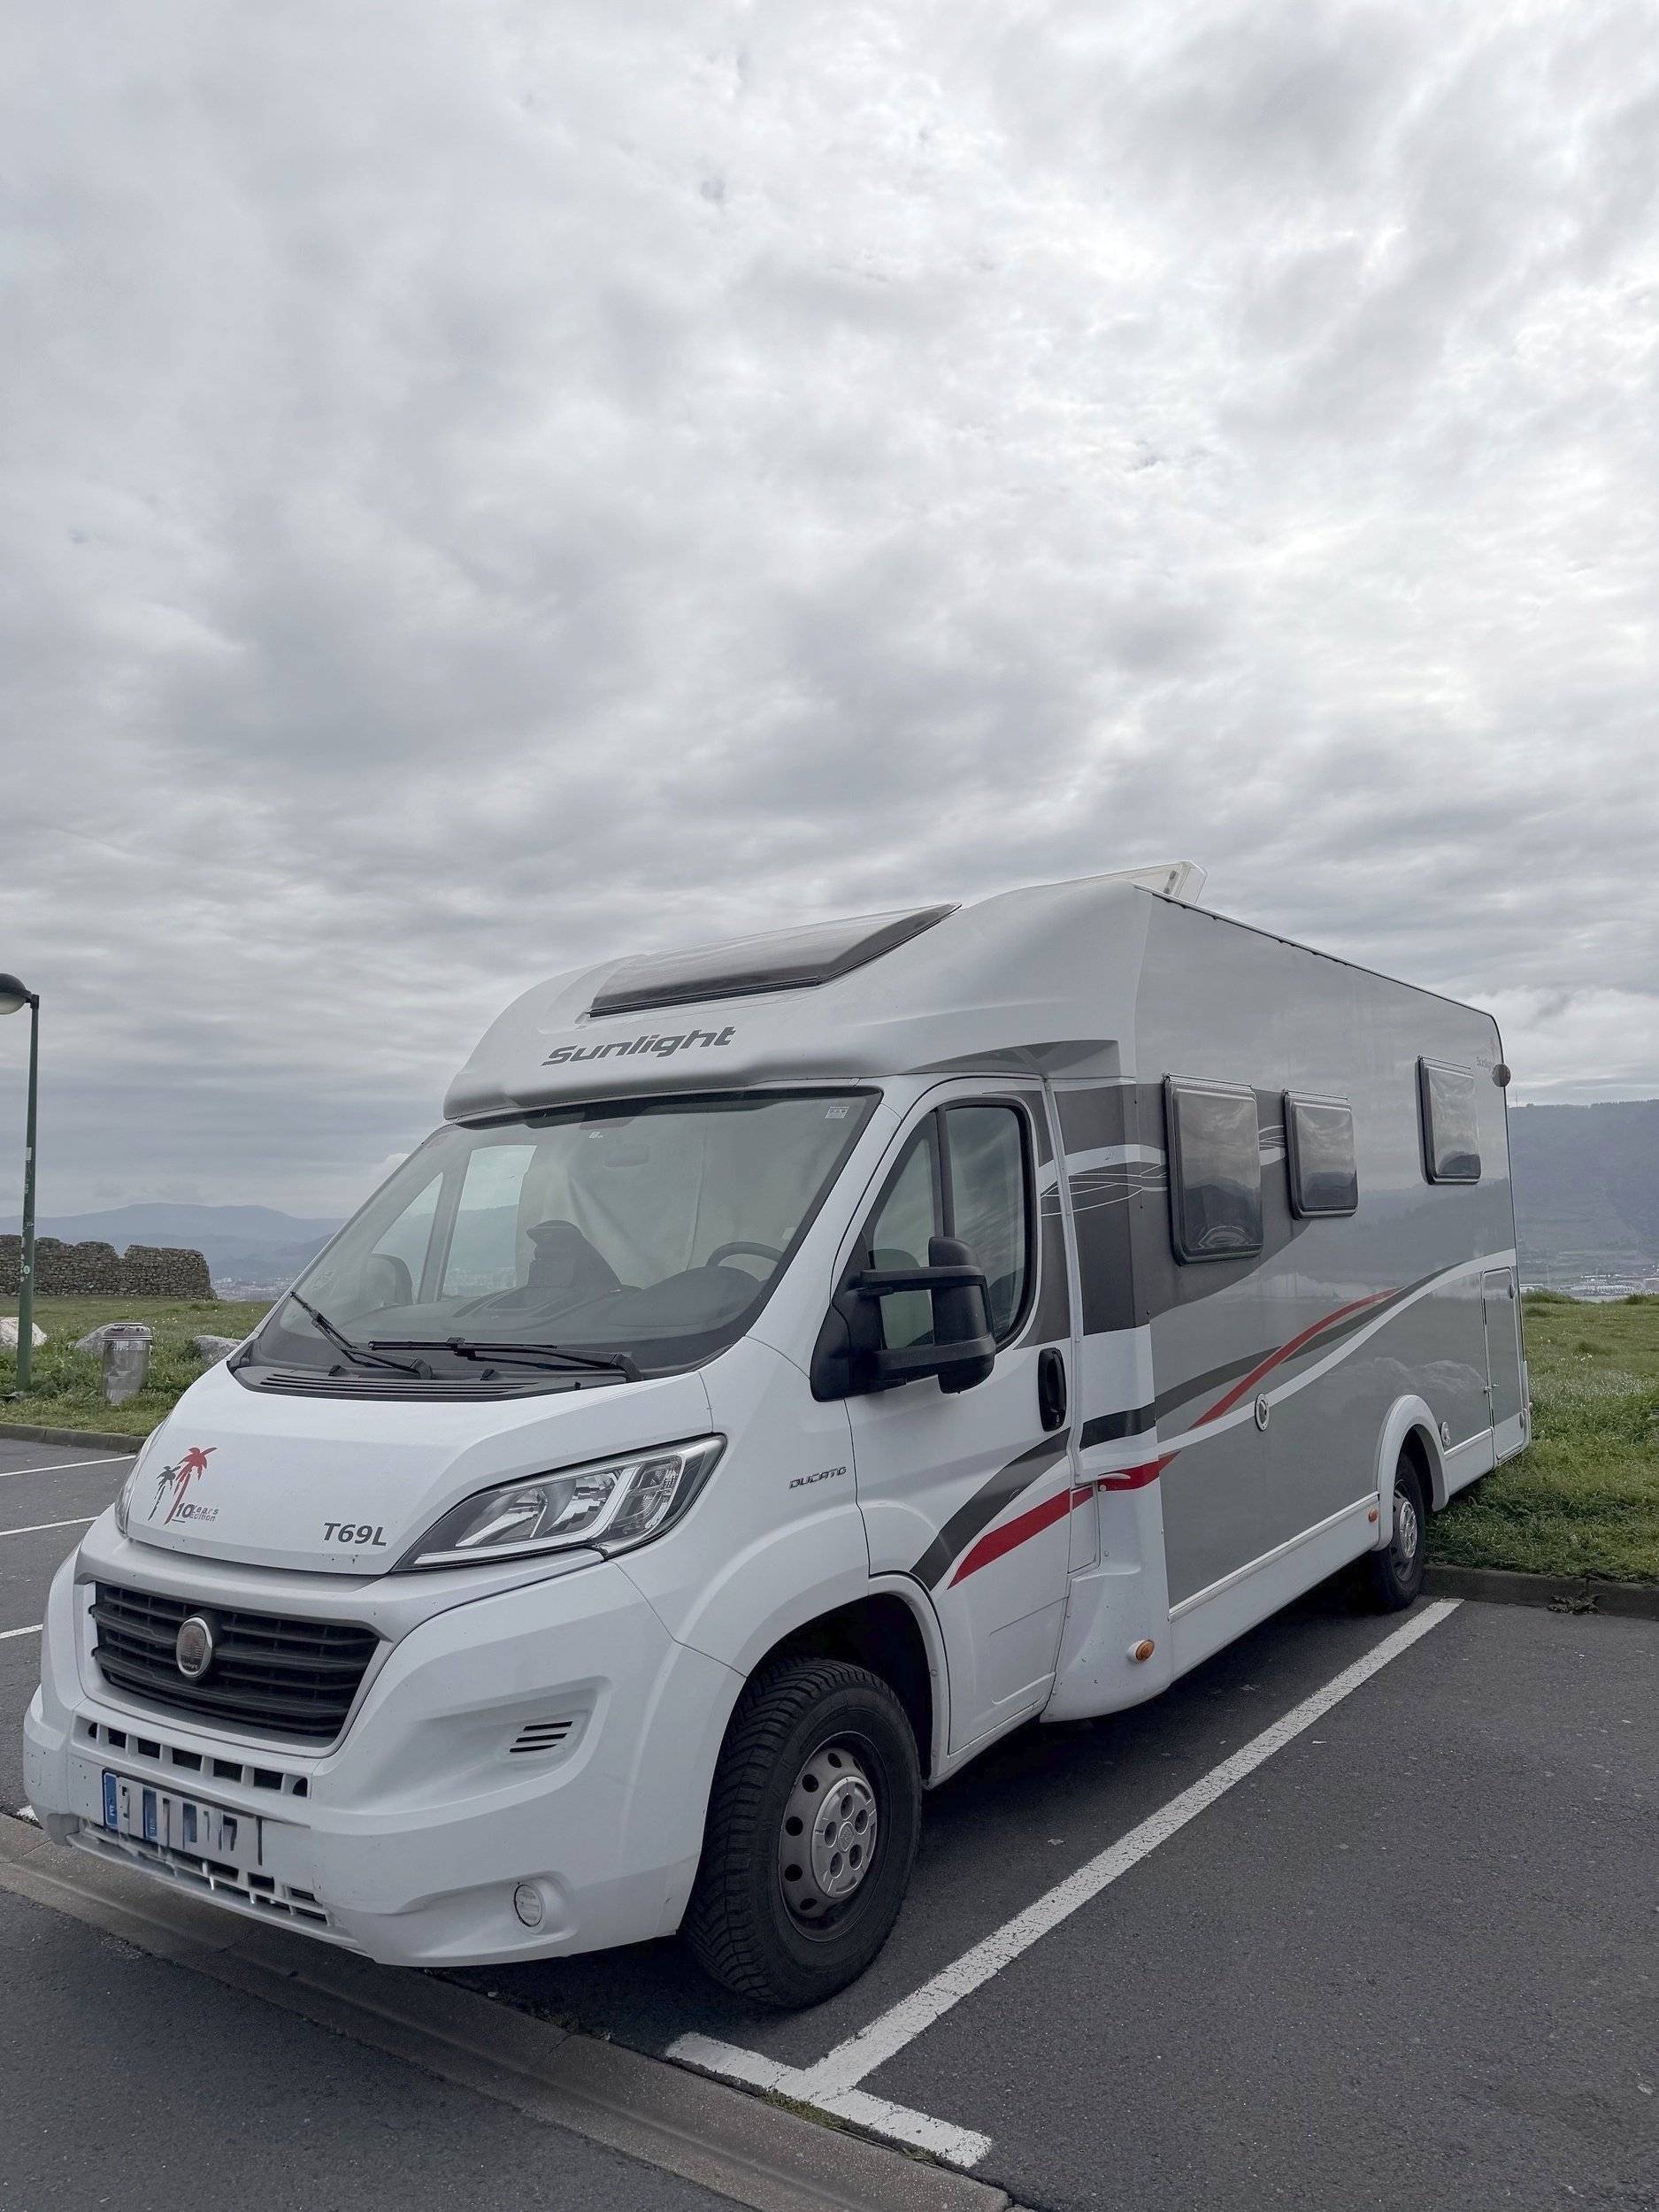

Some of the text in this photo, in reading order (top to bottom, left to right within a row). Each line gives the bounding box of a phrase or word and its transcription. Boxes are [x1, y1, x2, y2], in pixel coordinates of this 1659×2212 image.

[789, 1466, 847, 1489] DUCATO
[175, 1502, 195, 1518] 10
[323, 1522, 387, 1547] T69L
